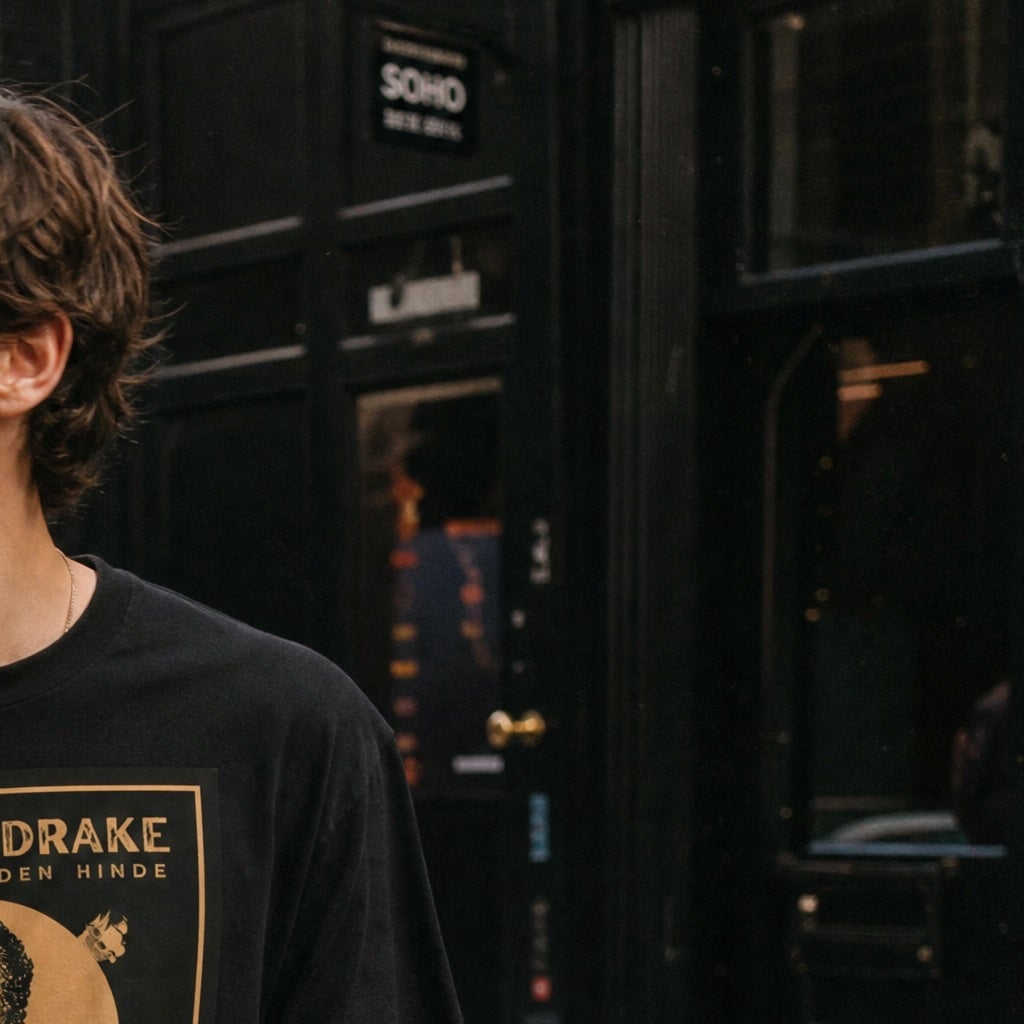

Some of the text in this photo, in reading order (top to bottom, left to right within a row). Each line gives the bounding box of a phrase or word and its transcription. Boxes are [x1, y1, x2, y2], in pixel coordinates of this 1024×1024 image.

[380, 63, 467, 113] SOHO
[1, 816, 171, 857] DRAKE
[77, 863, 167, 879] HINDE
